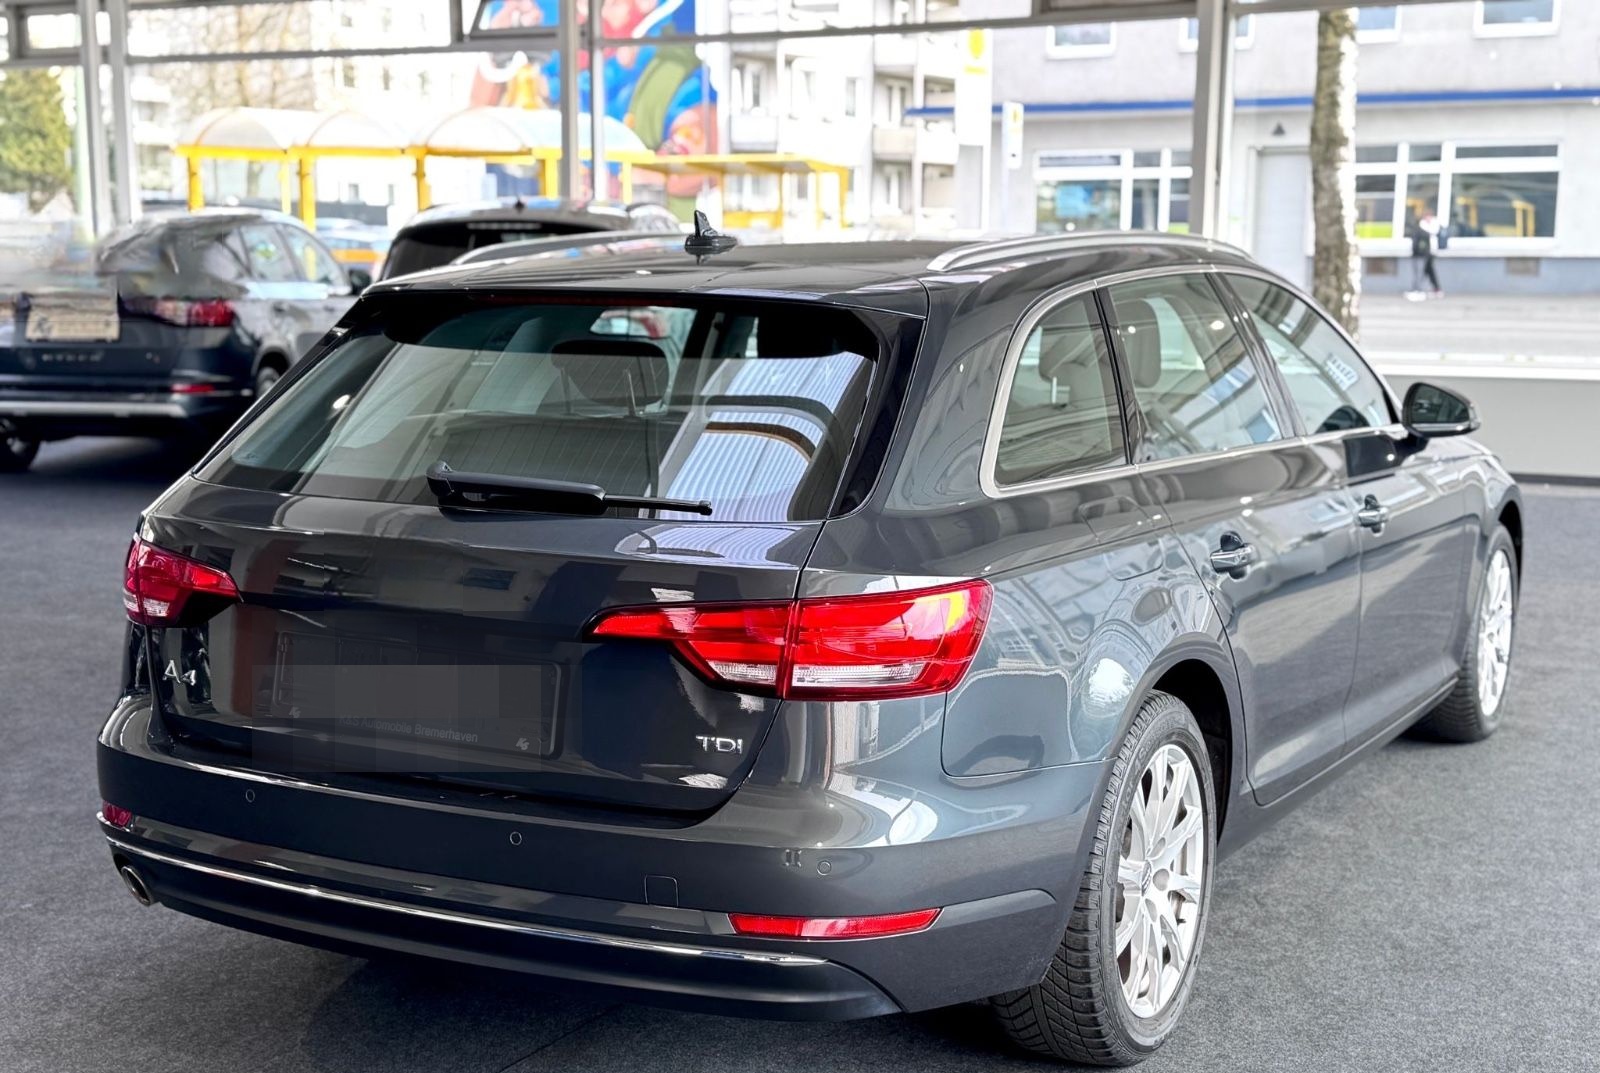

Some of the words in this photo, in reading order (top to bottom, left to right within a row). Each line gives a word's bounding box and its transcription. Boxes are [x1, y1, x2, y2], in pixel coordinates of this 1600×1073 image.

[162, 659, 197, 687] A4
[361, 716, 412, 734] Automobile
[414, 723, 478, 743] Bremerhaven
[695, 735, 743, 754] TDI
